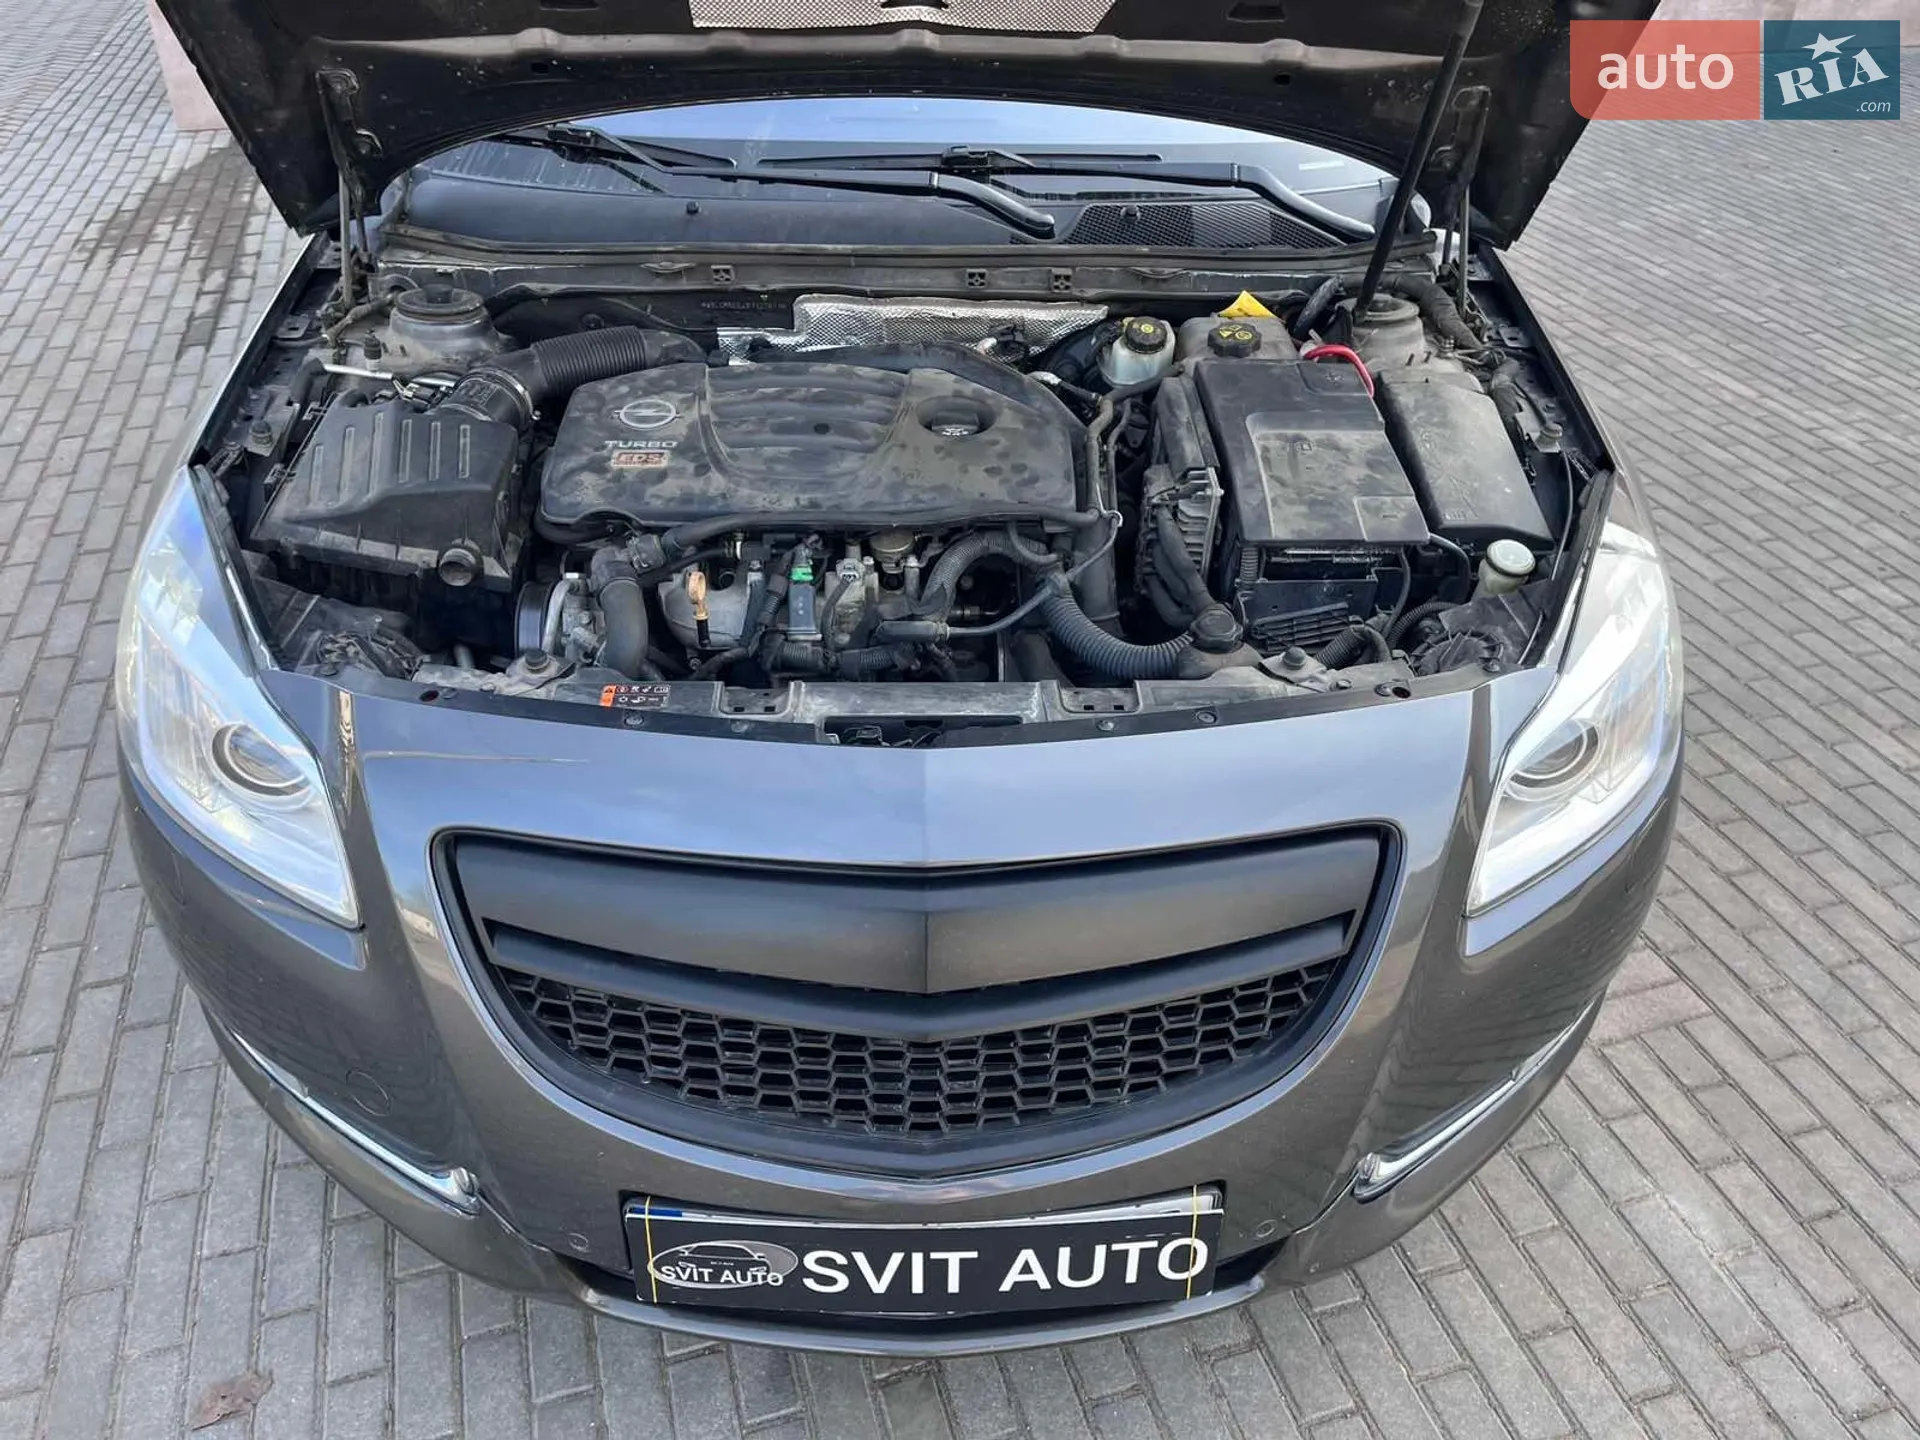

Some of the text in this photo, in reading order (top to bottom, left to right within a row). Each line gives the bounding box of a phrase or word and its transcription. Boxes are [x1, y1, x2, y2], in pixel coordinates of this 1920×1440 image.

[604, 440, 678, 449] TURBO
[660, 1265, 784, 1286] SVIT AUTO
[802, 1237, 1209, 1294] SVIT AUTO
